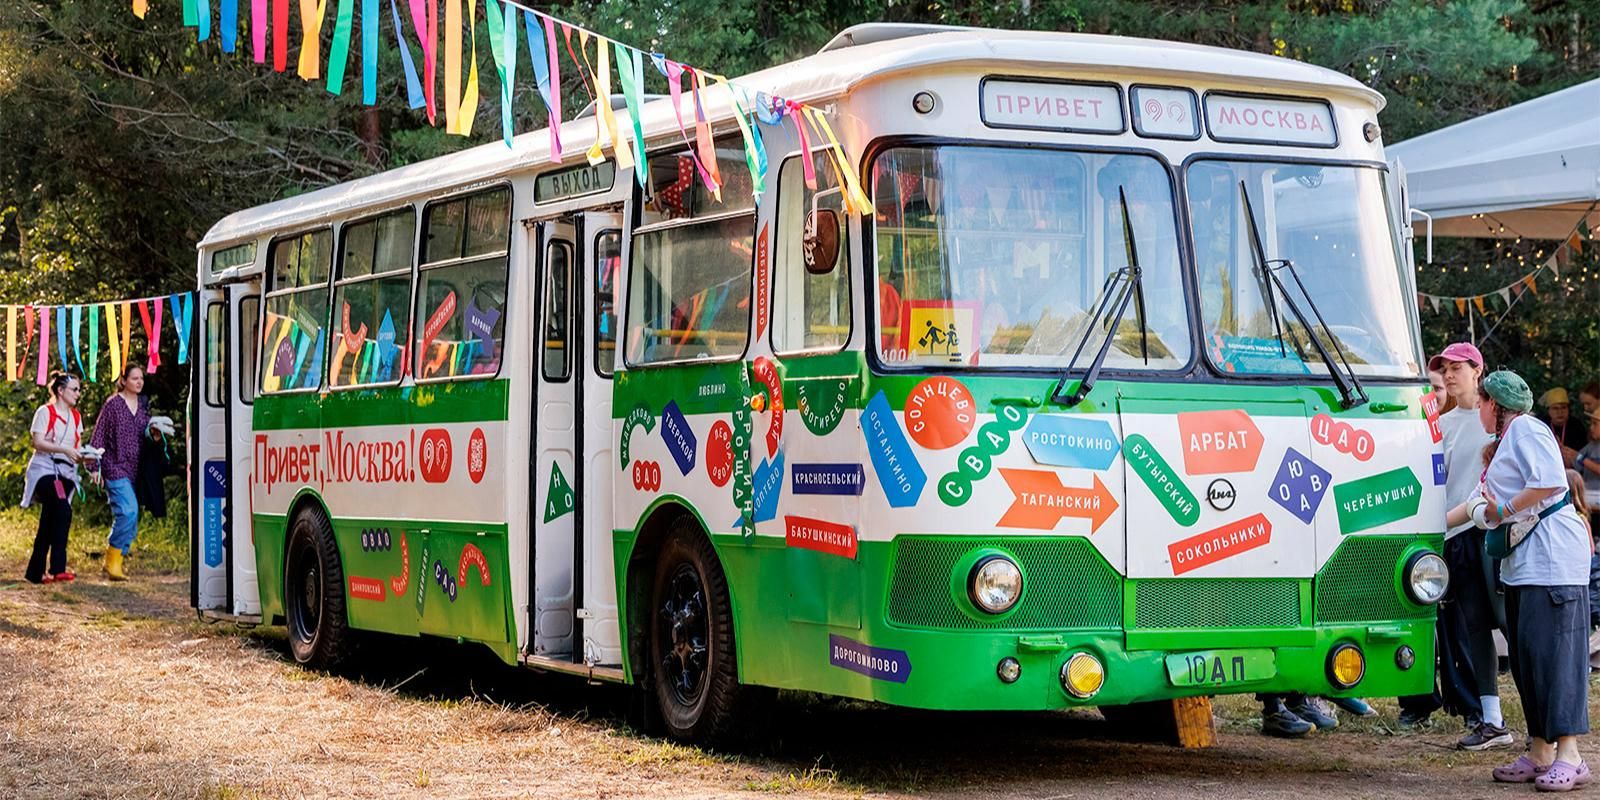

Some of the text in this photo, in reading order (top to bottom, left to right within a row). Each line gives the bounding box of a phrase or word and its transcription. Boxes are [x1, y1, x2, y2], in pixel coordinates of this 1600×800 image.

[995, 94, 1325, 131] ПРИВЕТ МОСКВА
[552, 166, 601, 196] ВЫХОД
[698, 383, 726, 397] ЛЮБЛИНО
[759, 364, 781, 440] КУЗЬМИНКИ
[799, 382, 846, 431] НОВОГИРЕЕВО
[909, 381, 970, 433] СОЛНЦЕВО
[622, 407, 651, 460] МЕДВЕДКОВО
[664, 411, 694, 463] ТВЕРСКОЙ
[945, 404, 1021, 499] СВАО
[1031, 432, 1113, 451] РОСТОКИНО
[1189, 430, 1249, 452] АРБАТ
[1317, 418, 1368, 455] ЦАО
[255, 428, 416, 494] Привет, Москва!
[712, 426, 731, 481] ЛЕФОРТОВО
[870, 411, 912, 494] ОСТАНКИНО
[635, 466, 658, 487] ВАО
[753, 467, 780, 514] КОПТЕВО
[795, 470, 862, 485] КРАСНОСЕЛЬСКИЙ
[1131, 443, 1193, 517] БУТЫРСКИЙ
[1021, 491, 1101, 510] ТАГАНСКИЙ
[1343, 484, 1415, 514] ЧЕРЁМУШКИ
[208, 502, 218, 562] РЯЗАНСКИЙ
[362, 532, 390, 548] ЮВАО
[791, 527, 852, 548] БАБУШКИНСКИЙ
[1176, 523, 1267, 565] СОКОЛЬНИКИ
[434, 563, 456, 597] САО
[833, 645, 899, 674] ДОРОГОМИЛОВО
